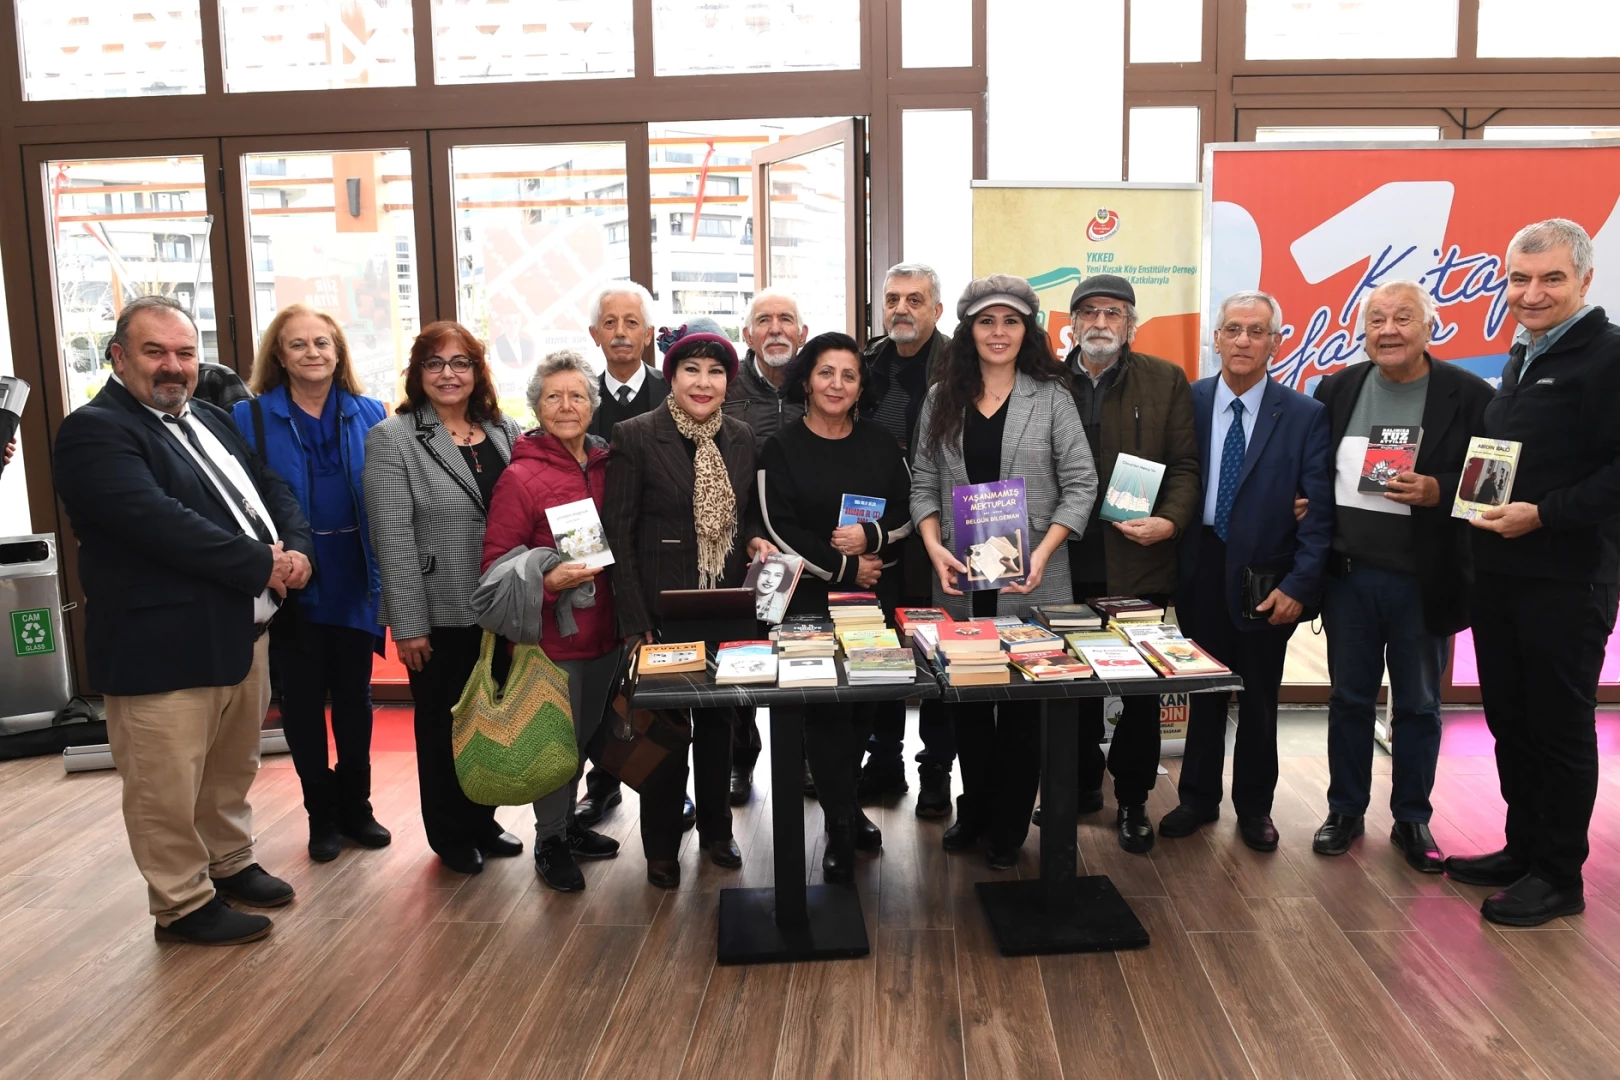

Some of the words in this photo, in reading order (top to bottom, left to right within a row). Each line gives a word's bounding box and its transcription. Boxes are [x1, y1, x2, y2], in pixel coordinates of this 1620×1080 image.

[1087, 252, 1114, 262] YKKED
[1086, 265, 1101, 273] Yeni
[1102, 265, 1122, 275] Kuşak
[1124, 265, 1136, 275] Köy
[1172, 265, 1198, 275] Derneği
[1130, 276, 1169, 285] Katkılarıyla
[1381, 432, 1409, 440] TUZ
[962, 488, 1020, 503] YAŞANMAMIŞ
[970, 498, 1017, 511] MEKTUPLAR
[22, 613, 40, 622] CAM
[25, 643, 46, 651] GLASS
